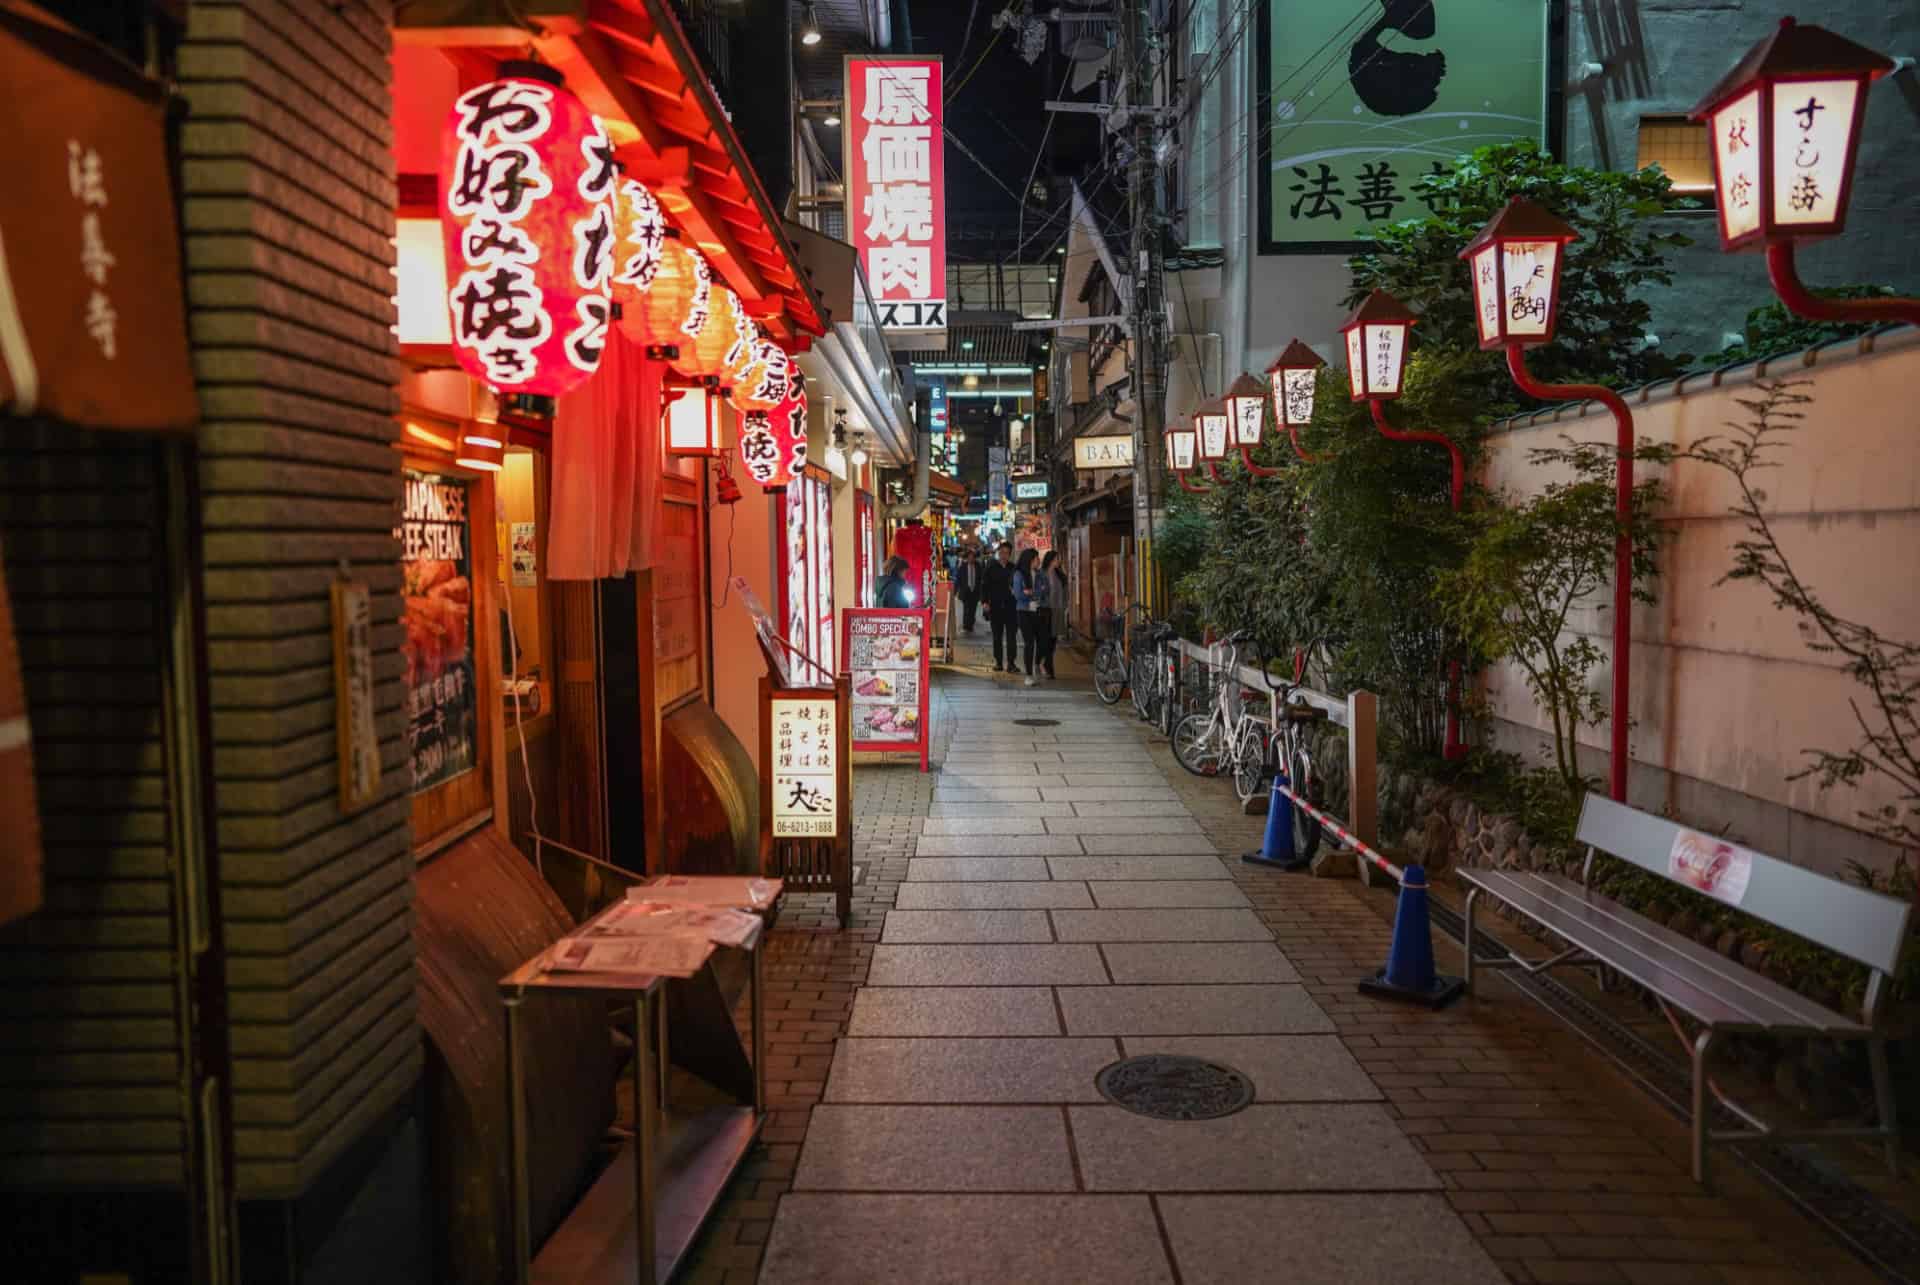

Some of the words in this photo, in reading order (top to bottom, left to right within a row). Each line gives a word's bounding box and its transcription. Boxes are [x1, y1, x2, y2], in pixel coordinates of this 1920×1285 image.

[861, 66, 934, 299] 原価焼肉
[455, 81, 551, 386] お好み焼き
[1086, 444, 1127, 460] BAR
[404, 481, 465, 521] JAPANESE
[424, 526, 464, 561] STEAK
[852, 623, 878, 634] COMBO
[879, 623, 910, 634] SPECIAL
[779, 709, 793, 767] 一品料理
[816, 706, 831, 768] お好み焼
[787, 781, 832, 812] 大たこ
